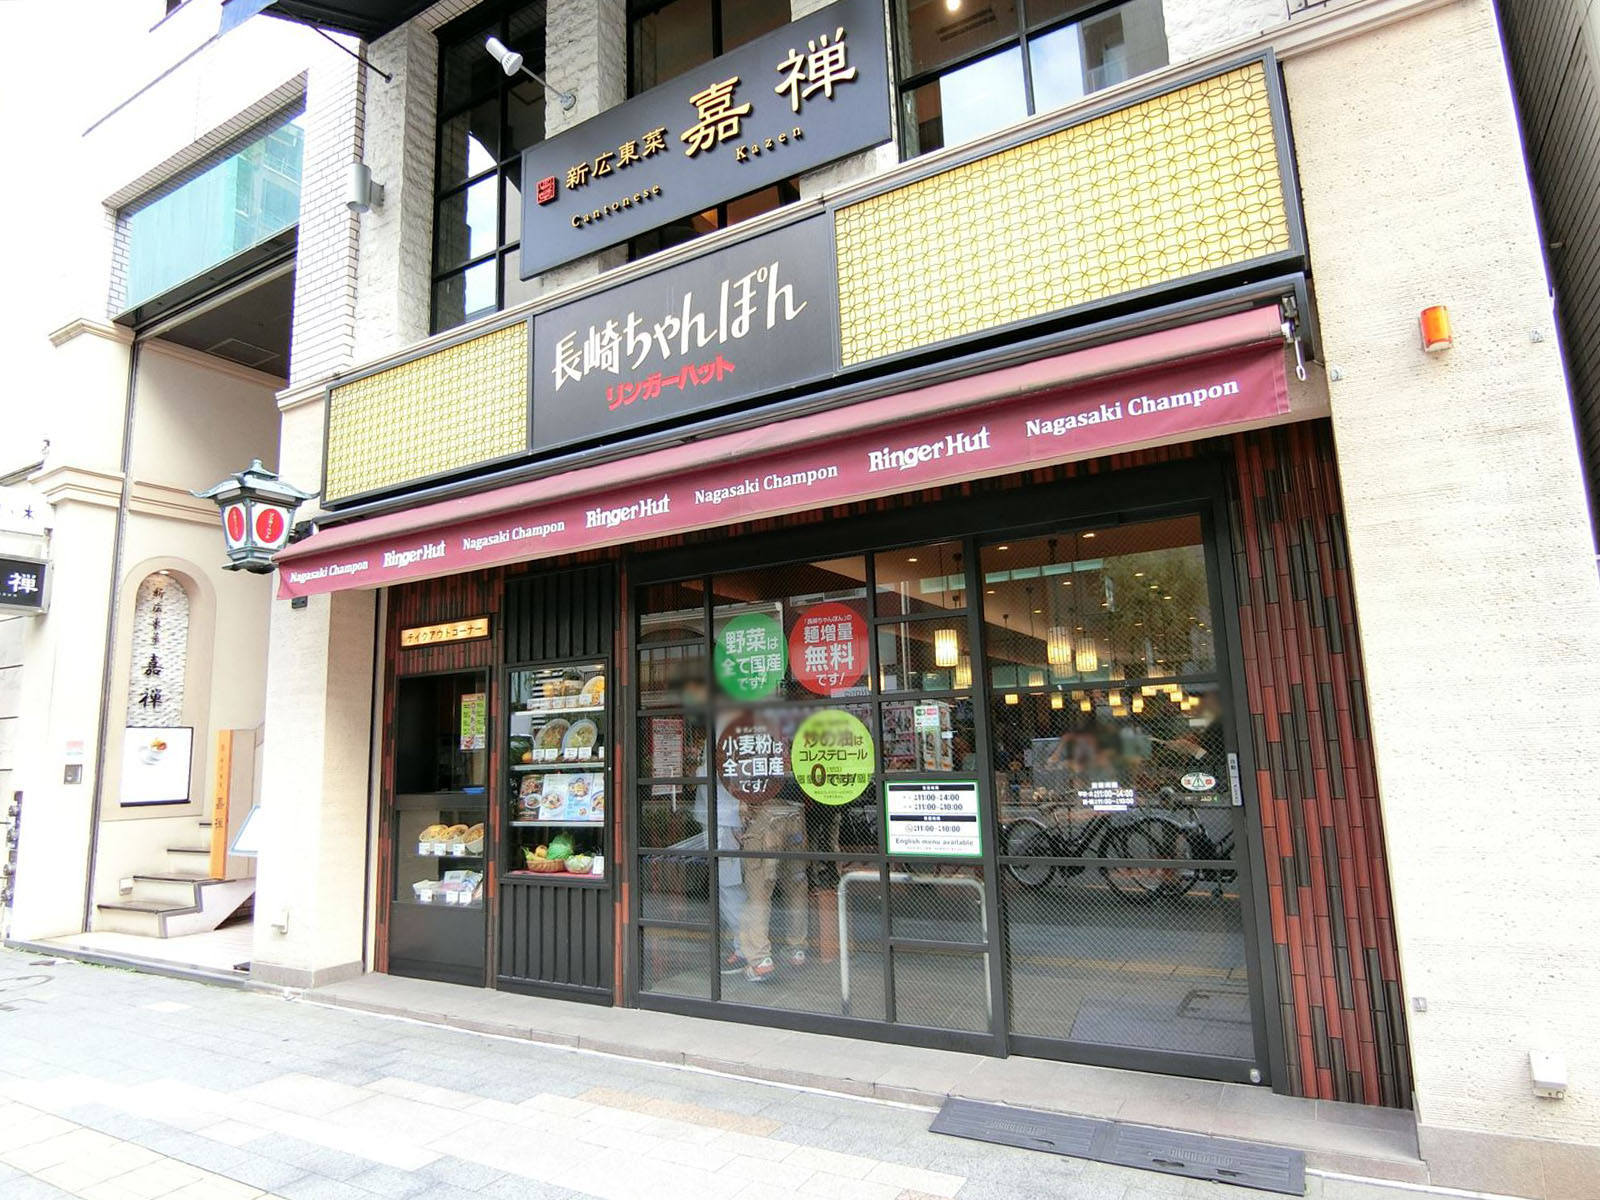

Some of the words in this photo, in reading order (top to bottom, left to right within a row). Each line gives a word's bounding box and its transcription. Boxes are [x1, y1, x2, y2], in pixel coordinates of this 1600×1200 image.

[566, 127, 667, 190] 新広東菜
[735, 127, 802, 162] Kazen
[571, 185, 662, 228] Cantonese
[552, 262, 807, 391] 長崎ちゃんぽん
[606, 354, 735, 411] リンガーハット
[1026, 402, 1122, 437] Nagasaki
[1128, 381, 1239, 416] Champon
[694, 479, 759, 504] Nagasaki
[763, 466, 838, 491] Champon
[463, 530, 509, 550] Nagasaki
[511, 521, 565, 541] Champon
[289, 567, 327, 584] Nagasaki
[328, 560, 369, 576] Champon
[407, 624, 483, 643] テイクアウトコーナー
[725, 627, 779, 655] 野菜は
[721, 653, 782, 676] 全て国産
[805, 643, 854, 672] 無料
[722, 734, 783, 756] 小麦粉は
[799, 749, 868, 762] コレステロール
[722, 757, 784, 777] 全て国産
[943, 838, 973, 846] available
